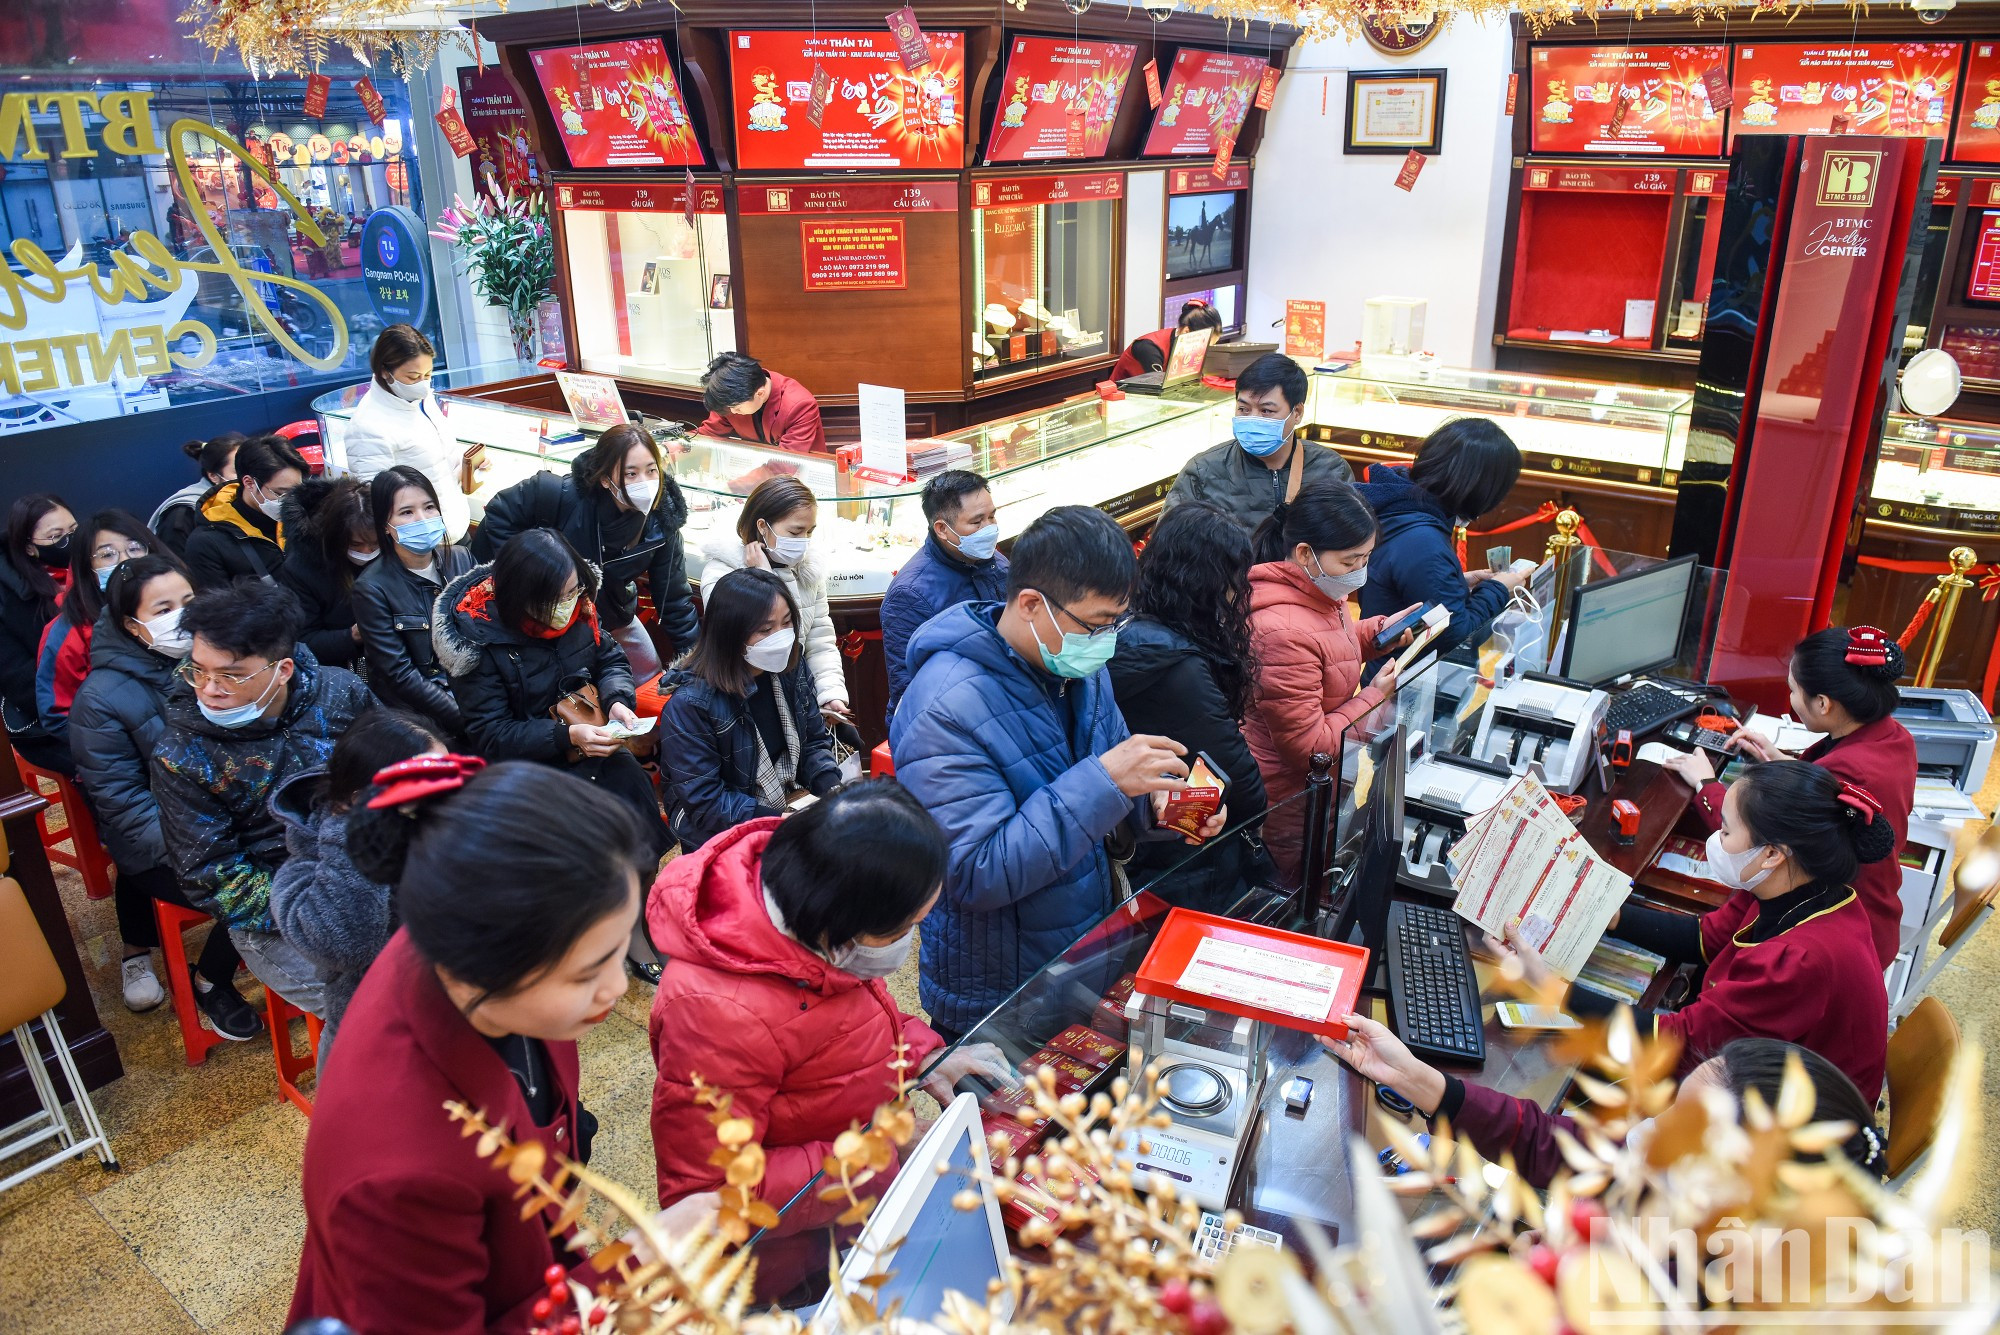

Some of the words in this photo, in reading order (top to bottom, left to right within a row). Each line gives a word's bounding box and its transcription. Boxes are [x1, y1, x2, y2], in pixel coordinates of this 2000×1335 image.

[1373, 18, 1380, 28] 8
[1383, 30, 1390, 39] 7
[829, 37, 855, 48] THẦN
[857, 38, 873, 48] TÀI
[1611, 51, 1633, 60] THẦN
[1826, 49, 1852, 57] THẦN
[1854, 49, 1869, 57] TÀI
[503, 95, 512, 104] TÀI
[1634, 182, 1649, 190] CẦU
[1650, 182, 1667, 191] GIẤY
[811, 190, 826, 198] BẢO
[904, 189, 920, 198] 139
[1049, 191, 1058, 199] CẦU
[1059, 190, 1069, 198] GIẤY
[110, 201, 146, 211] SAMSUNG
[631, 200, 643, 208] CẦU
[643, 199, 654, 208] GIẤY
[825, 200, 848, 208] CHÂU
[894, 198, 910, 208] CẦU
[912, 198, 931, 208] GIẤY
[1836, 219, 1872, 229] BTMC
[1805, 220, 1870, 256] Jewelry
[1820, 246, 1867, 257] CENTER
[365, 268, 393, 280] Gangnam
[394, 271, 420, 283] PO-CHA
[380, 286, 392, 300] 강남
[1293, 302, 1309, 310] THẦN
[1985, 512, 1997, 520] SỨC
